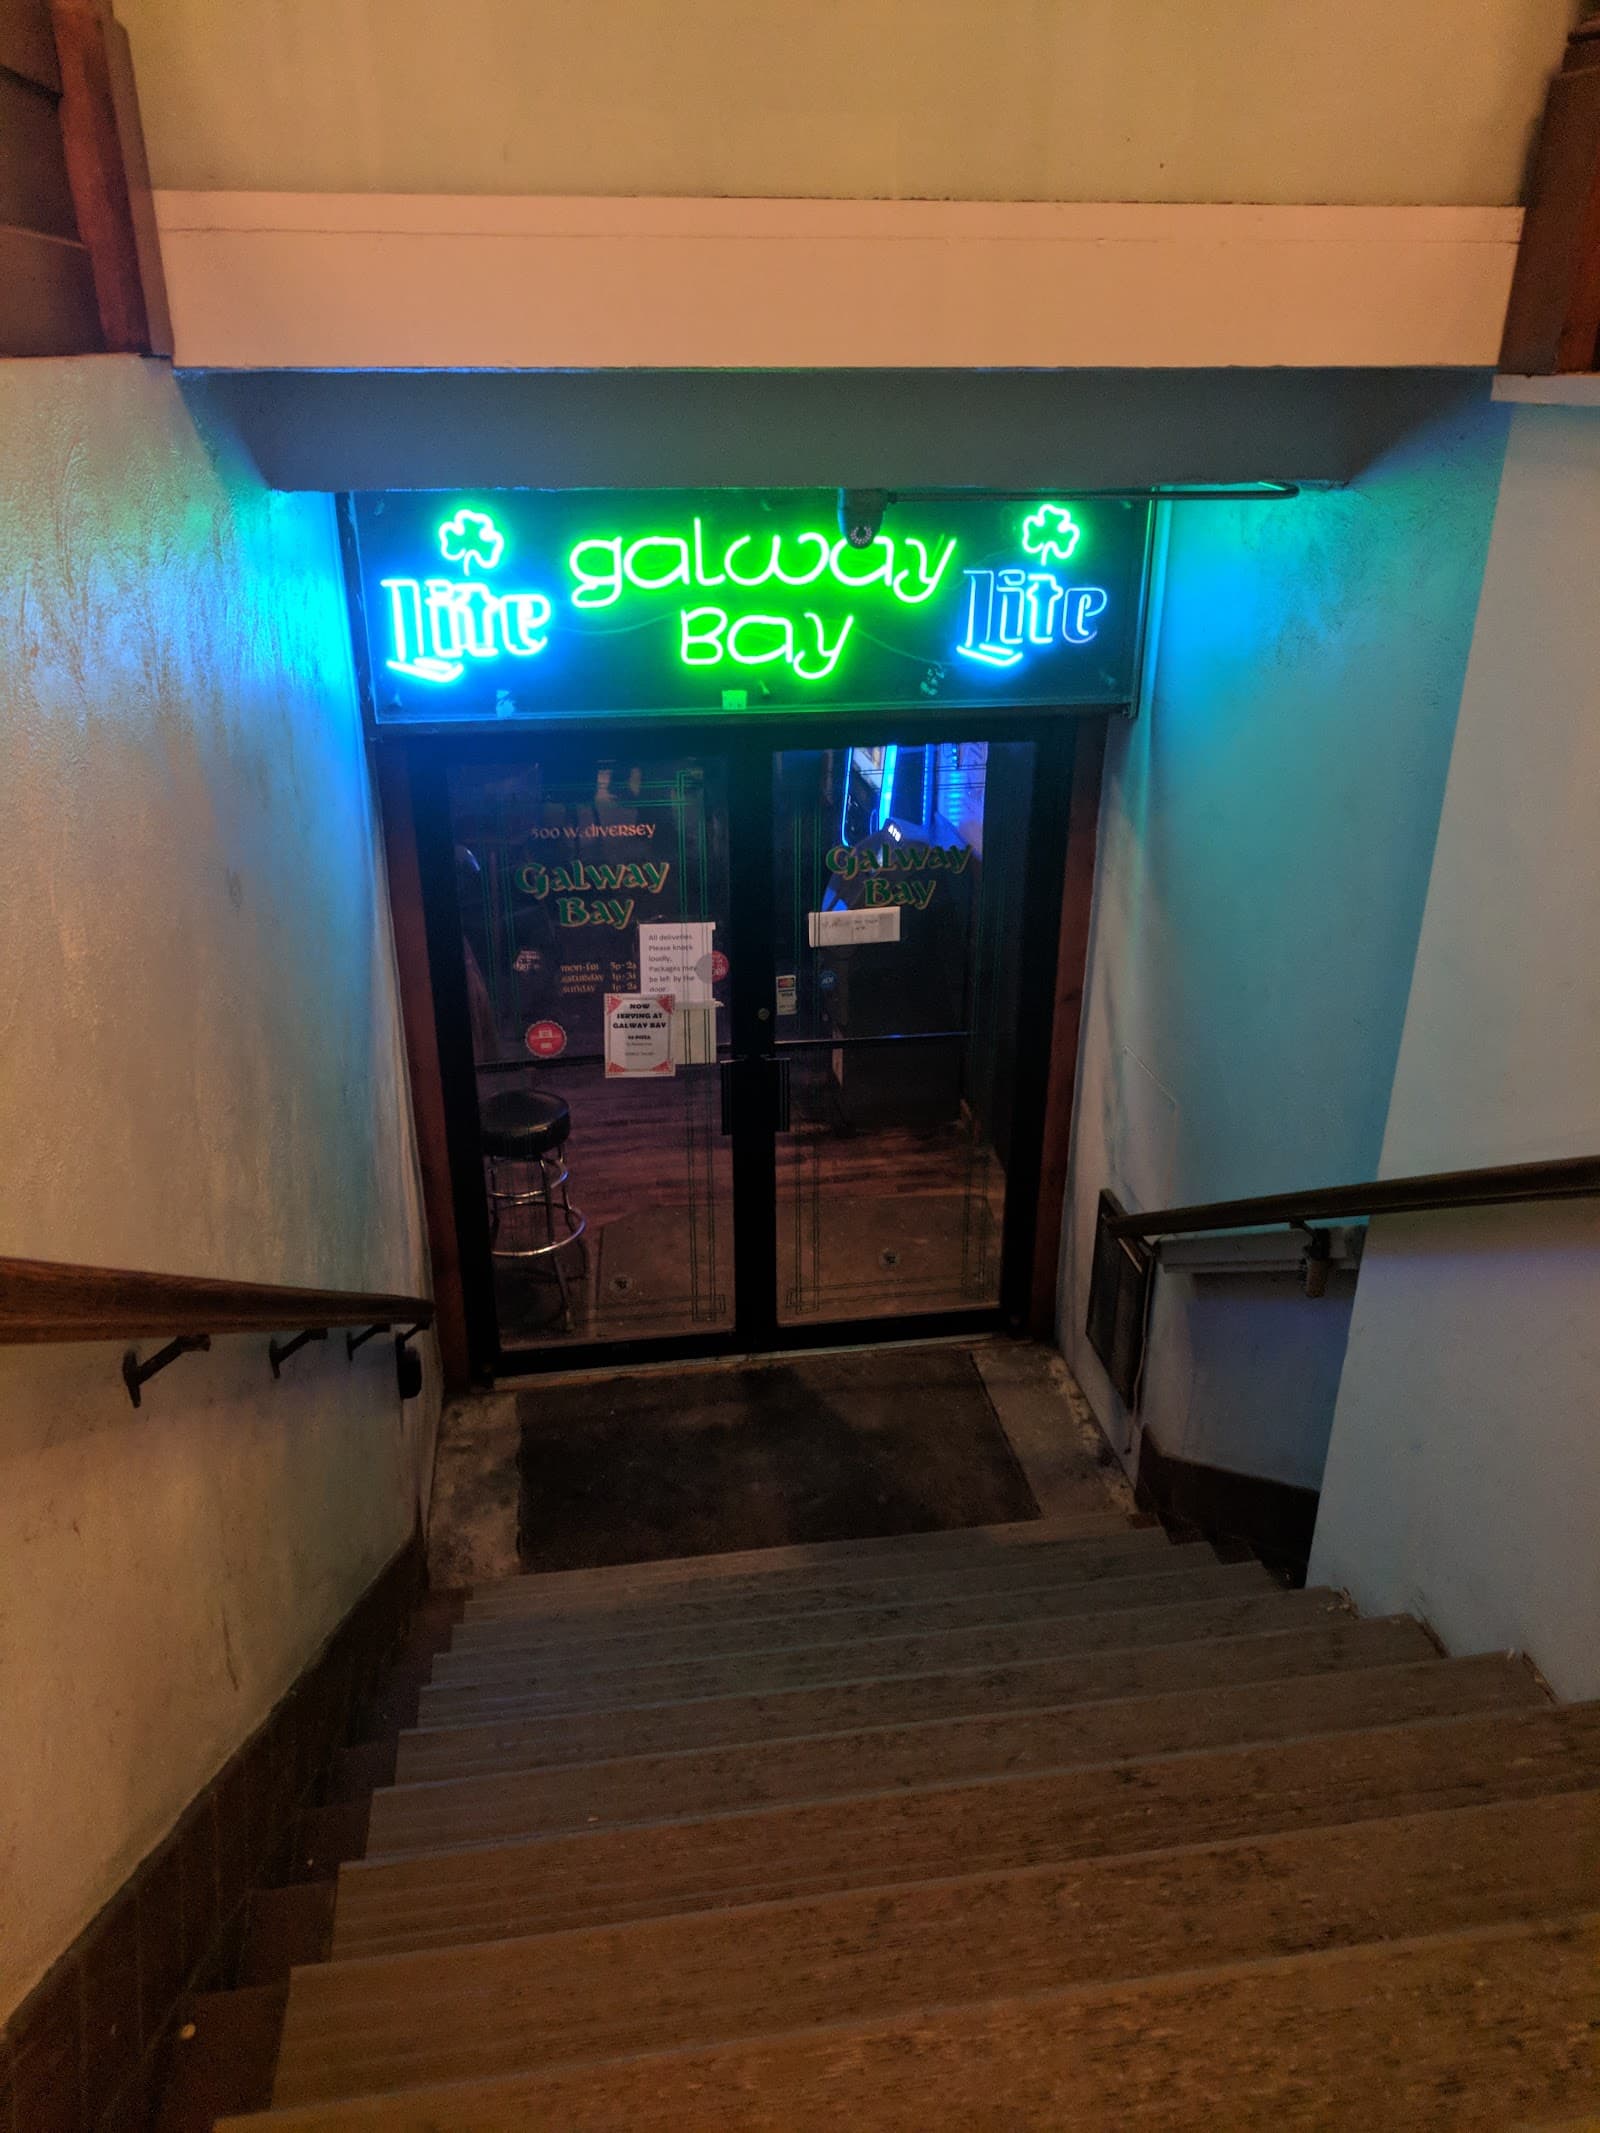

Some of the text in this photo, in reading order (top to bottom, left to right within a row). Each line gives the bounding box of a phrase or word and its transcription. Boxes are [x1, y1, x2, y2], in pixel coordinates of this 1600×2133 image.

[569, 517, 957, 608] galway
[380, 578, 552, 683] Lite
[956, 568, 1107, 667] Lite
[679, 606, 854, 680] Bay
[516, 859, 670, 900] Galway
[825, 843, 973, 880] Galway
[556, 896, 635, 930] Bay
[863, 877, 936, 910] Bay
[673, 944, 693, 952] knock
[673, 975, 681, 983] by
